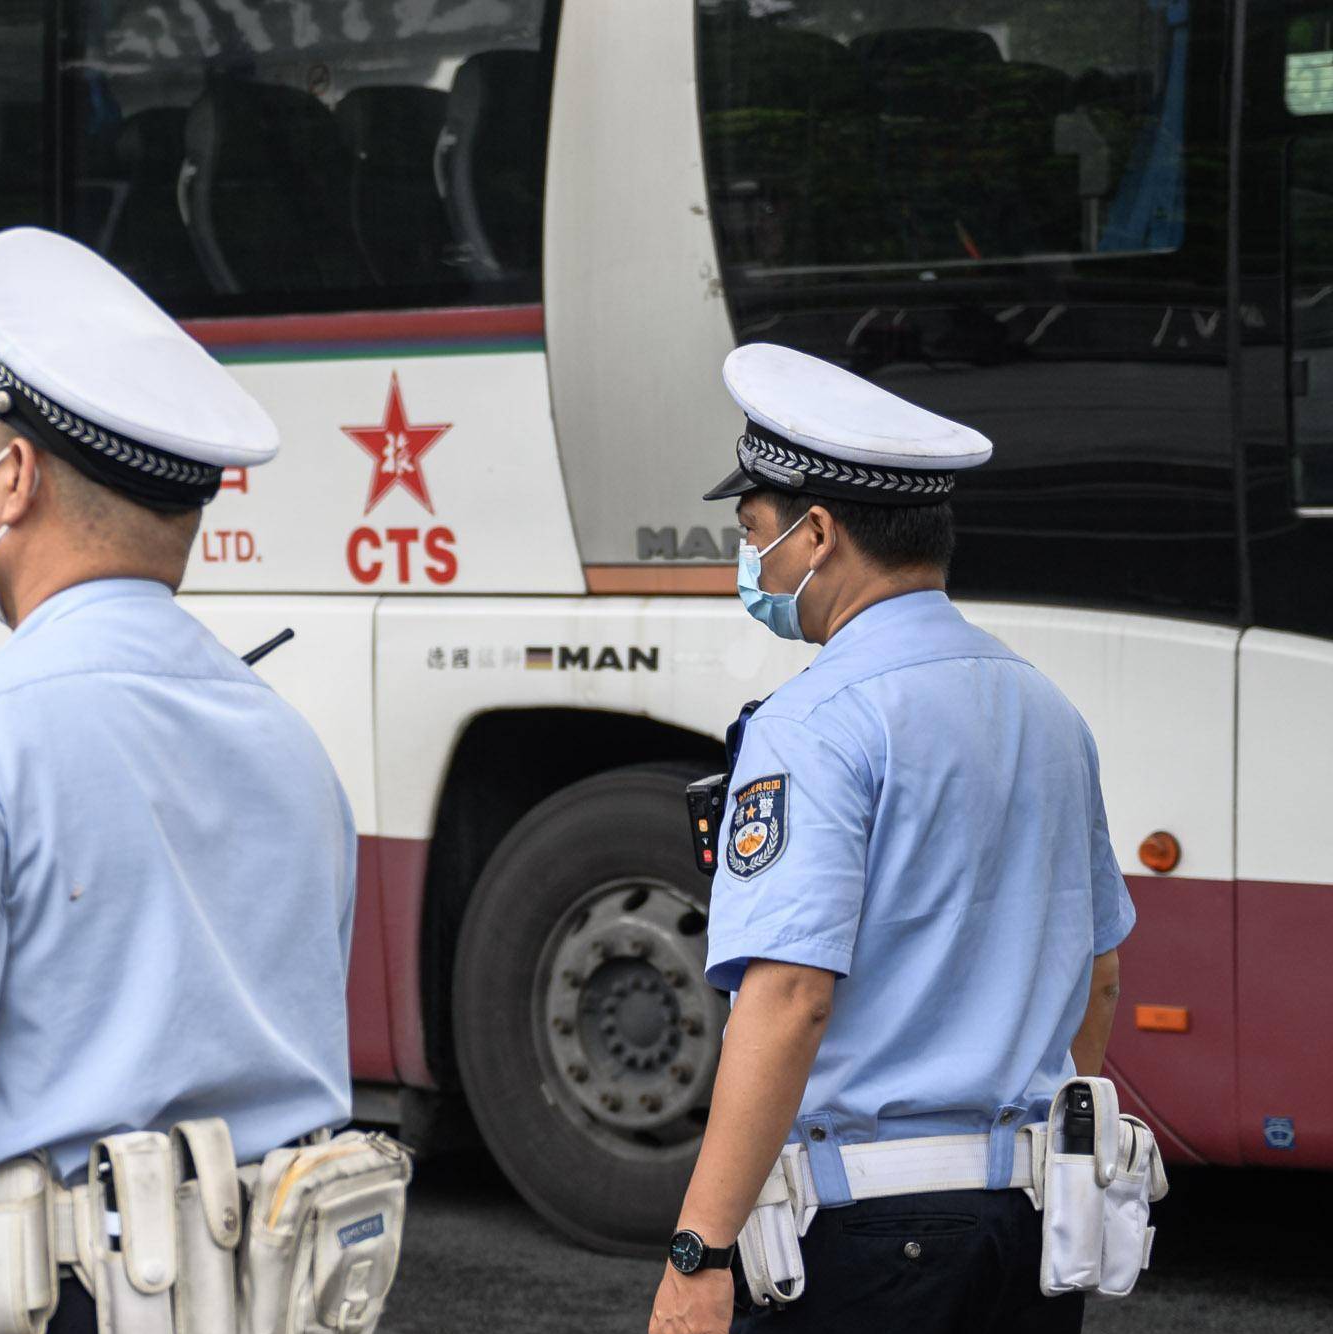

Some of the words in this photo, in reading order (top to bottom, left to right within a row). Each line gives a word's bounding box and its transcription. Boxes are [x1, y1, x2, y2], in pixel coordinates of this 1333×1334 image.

[202, 531, 263, 562] LTD.
[346, 525, 458, 585] CTS
[558, 645, 661, 672] MAN
